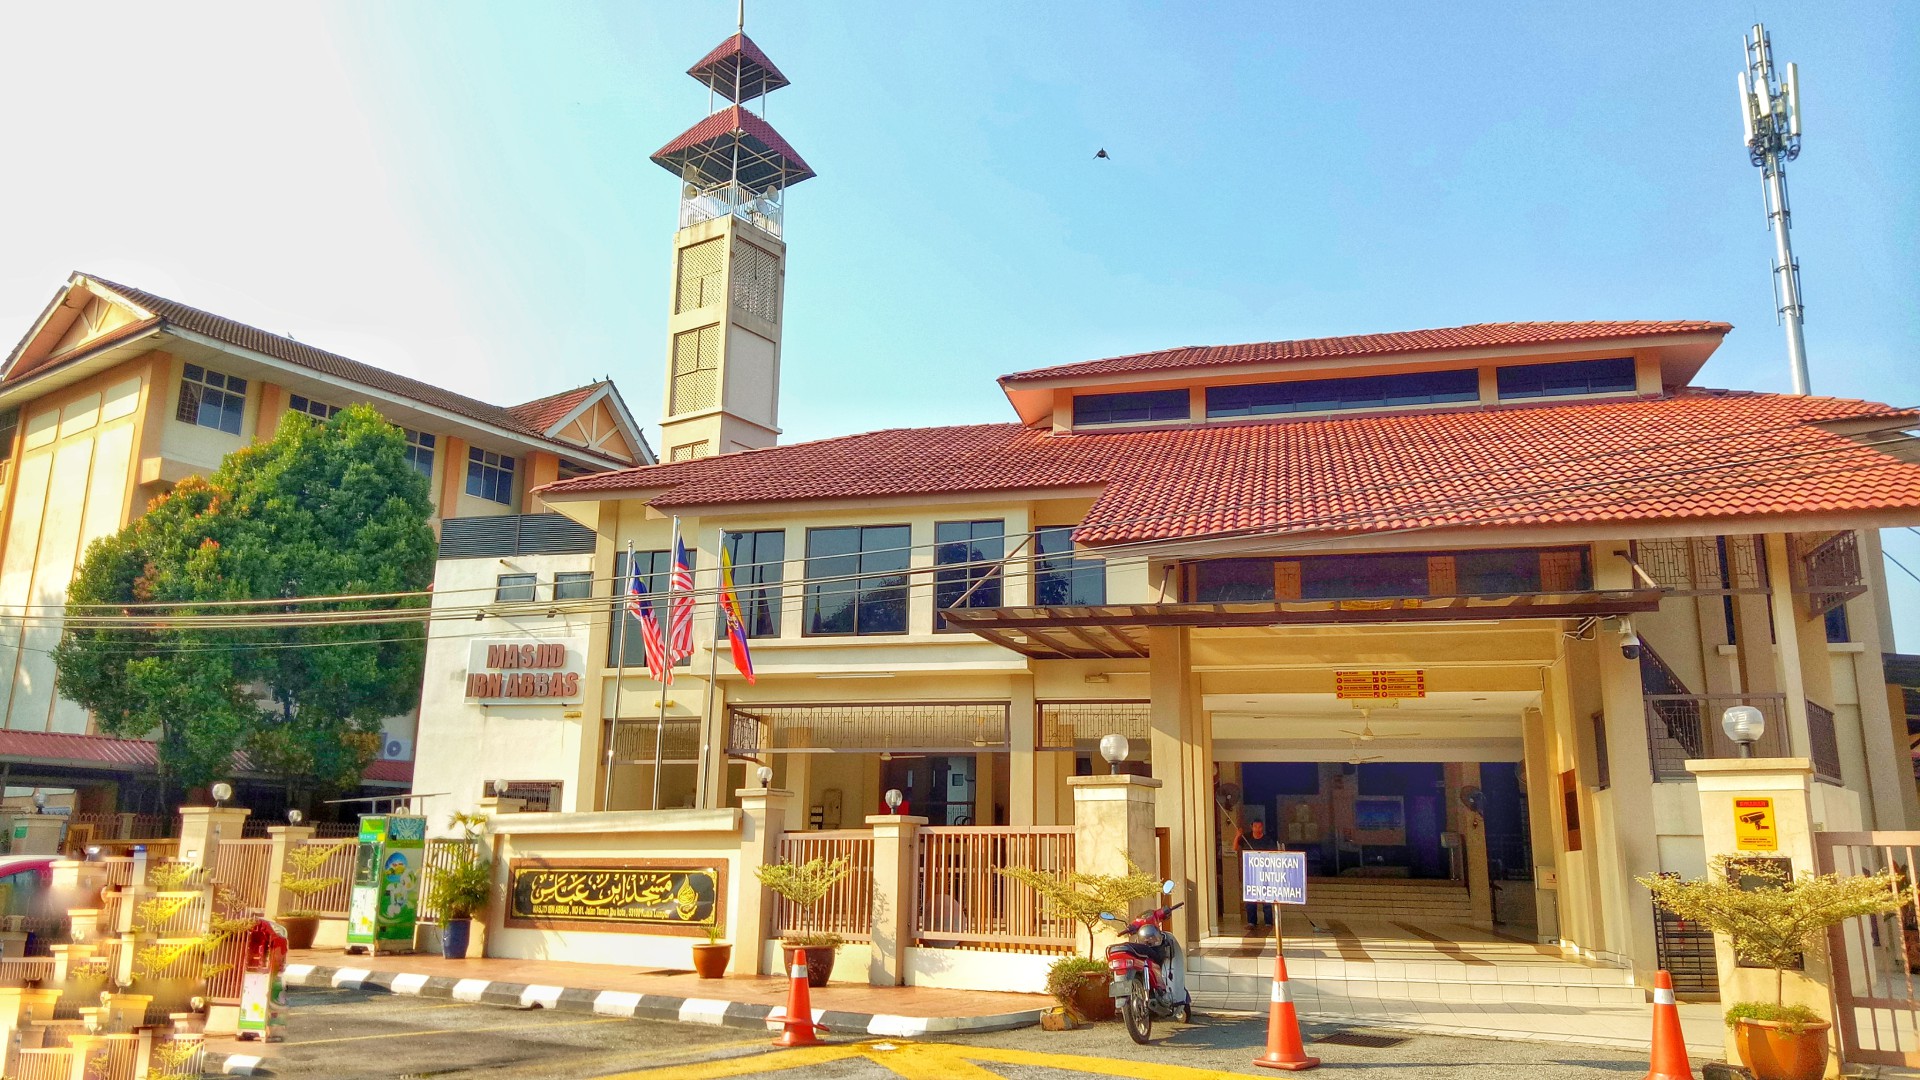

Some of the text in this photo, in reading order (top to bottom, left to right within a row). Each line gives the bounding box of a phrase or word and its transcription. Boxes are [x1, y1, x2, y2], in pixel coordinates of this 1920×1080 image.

[486, 643, 565, 669] MASJID
[465, 671, 579, 698] IBN ABBAS
[1248, 856, 1299, 869] KOSONGKAN
[1259, 871, 1287, 883] UNTUK
[1246, 885, 1302, 898] PENCERAMAH
[532, 904, 548, 914] MASJID
[547, 904, 555, 914] IBN
[572, 905, 579, 915] NO
[585, 906, 596, 916] Jalan
[596, 906, 610, 916] Taman
